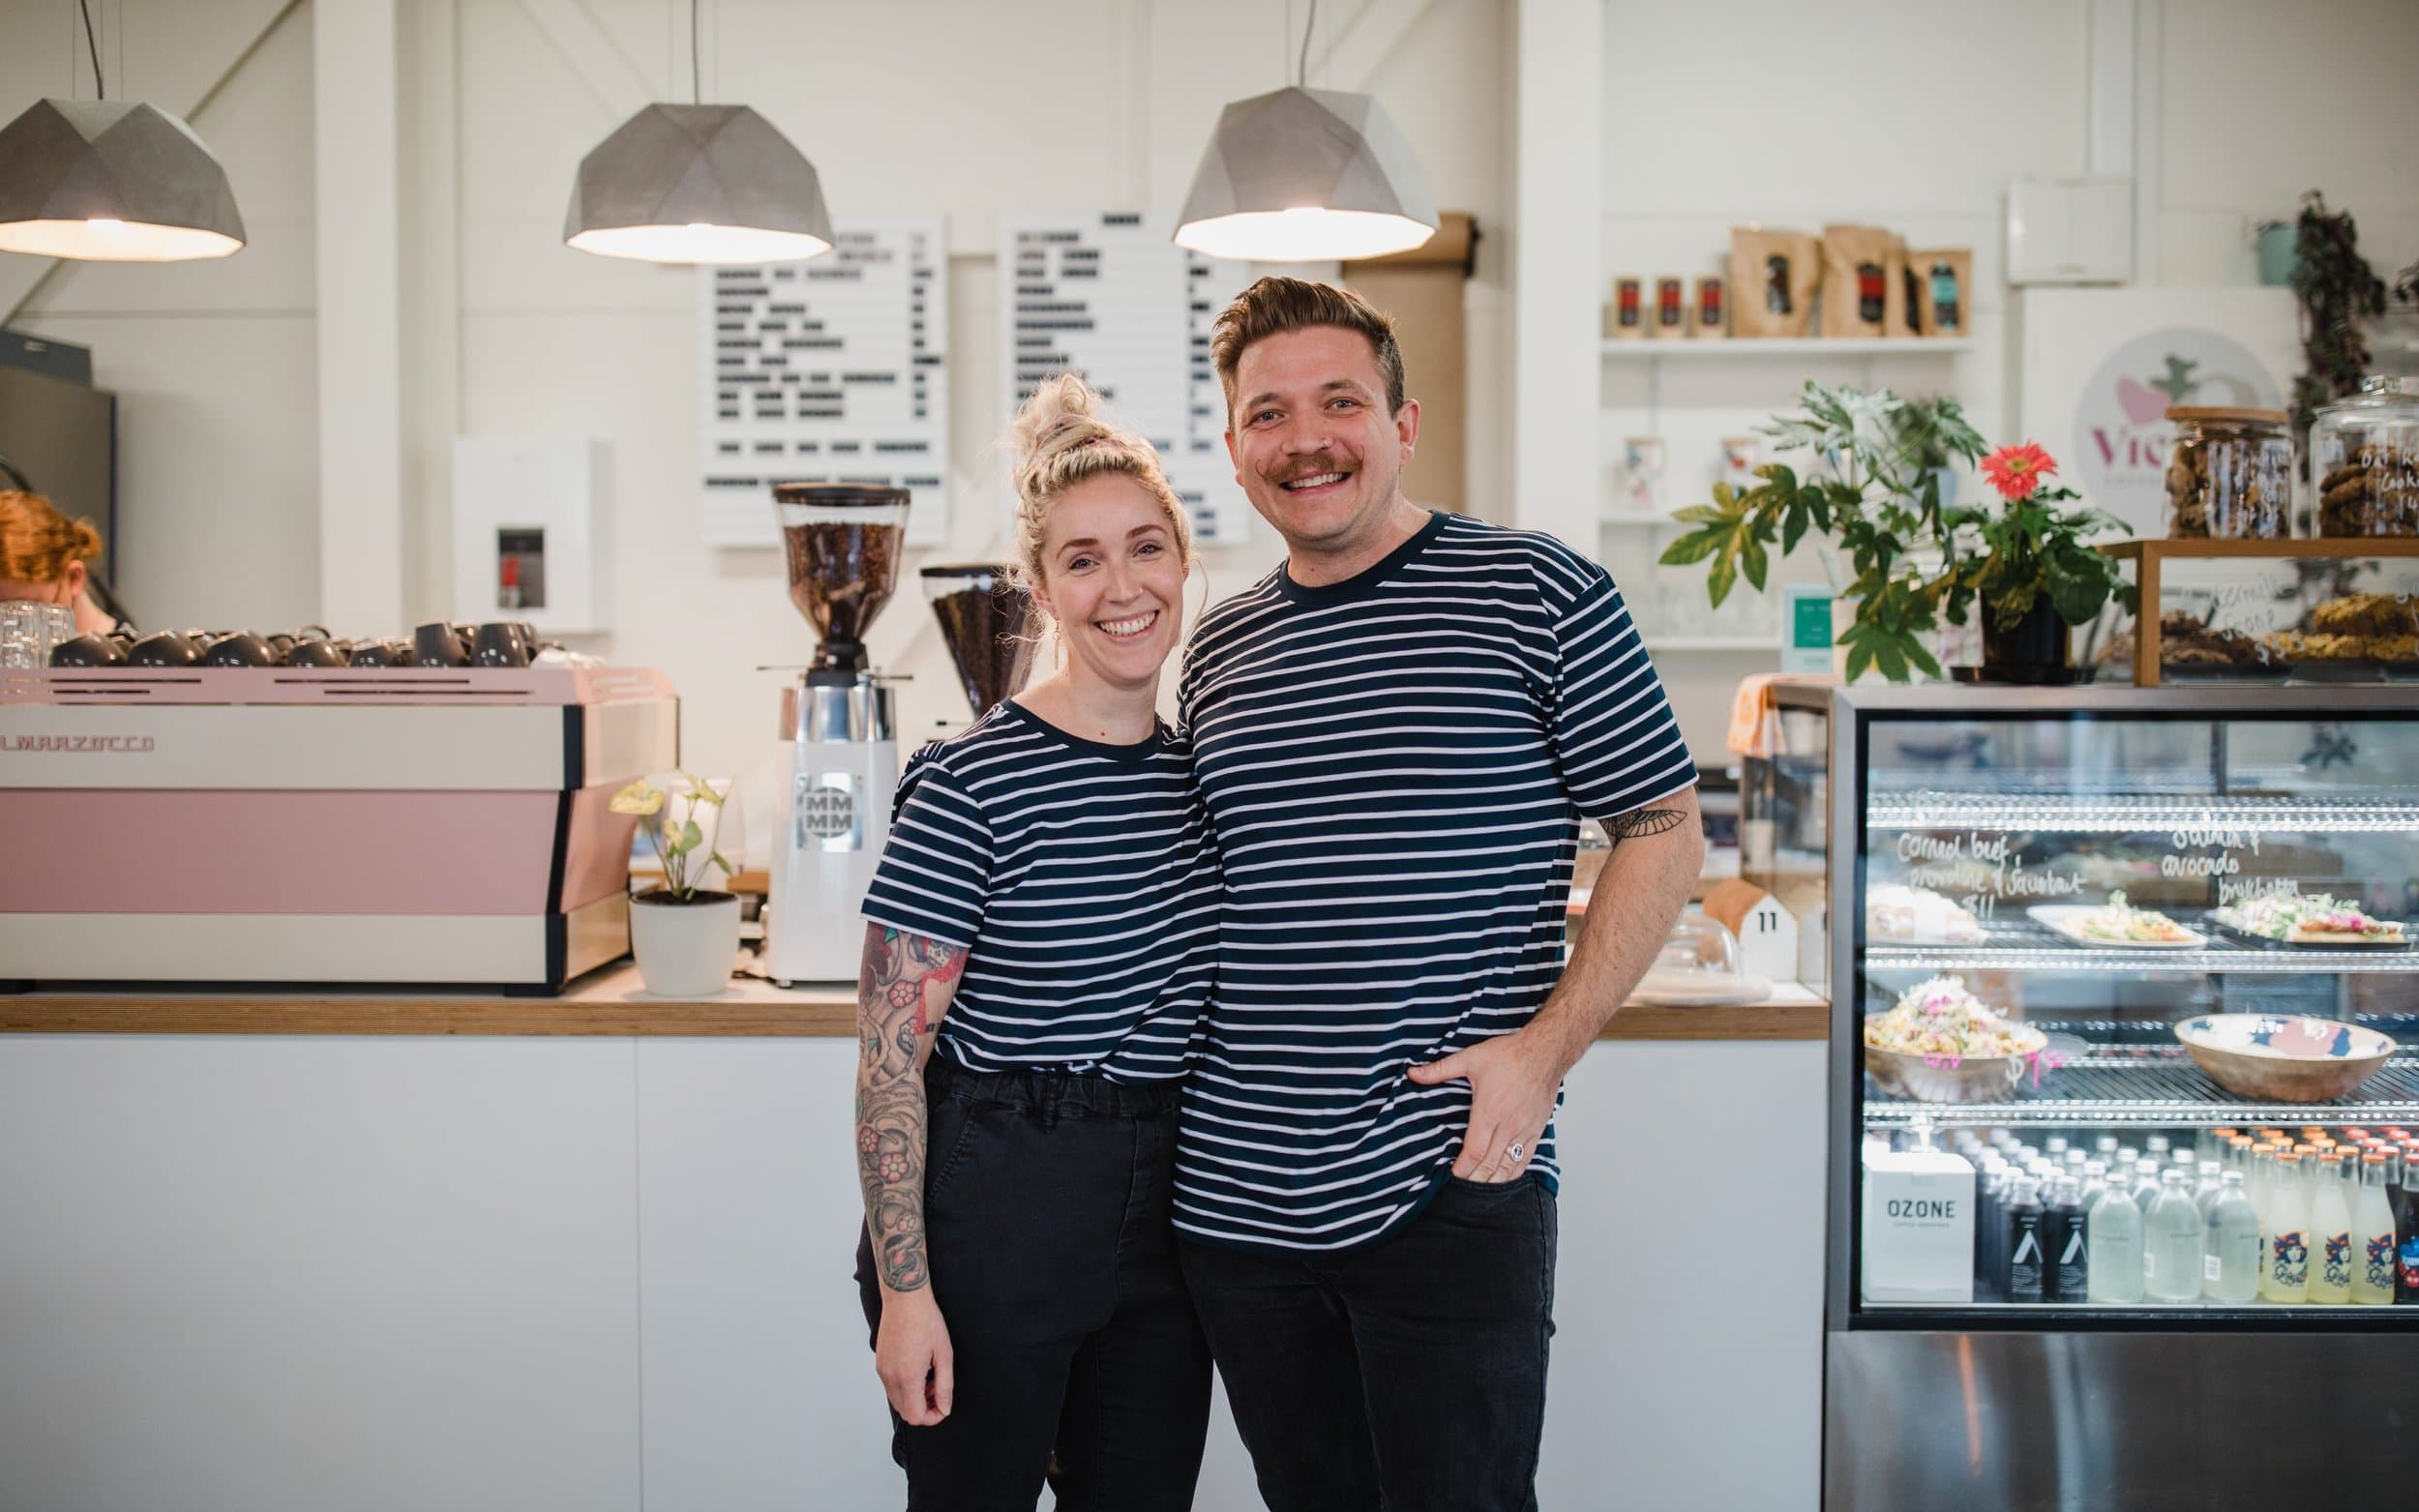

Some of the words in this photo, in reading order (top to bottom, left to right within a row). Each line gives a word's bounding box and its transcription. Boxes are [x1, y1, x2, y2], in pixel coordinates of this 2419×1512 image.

[16, 734, 155, 752] MARZOCCO
[1897, 833, 1961, 862] Corned
[1971, 832, 2011, 864] beef
[2162, 850, 2240, 876] avocado
[1758, 911, 1777, 933] 11
[1887, 1200, 1956, 1219] OZONE
